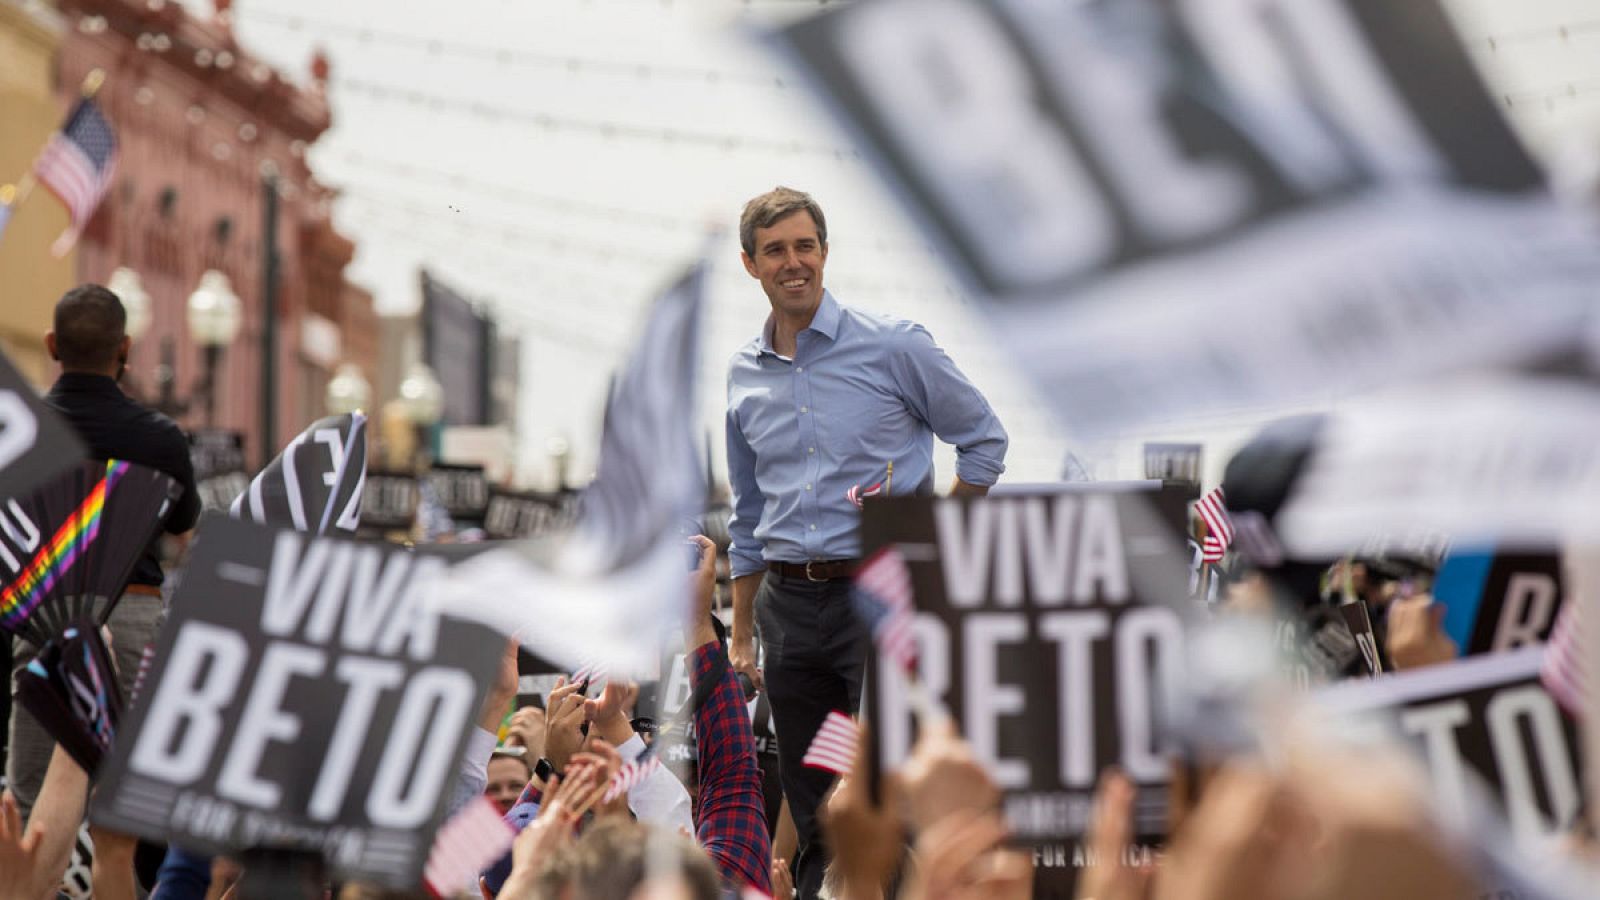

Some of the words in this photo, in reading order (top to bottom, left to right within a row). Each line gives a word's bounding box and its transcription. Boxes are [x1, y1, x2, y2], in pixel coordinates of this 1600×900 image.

[259, 528, 442, 662] VIVA
[935, 497, 1131, 605] VIVA
[128, 618, 477, 831] BETO
[1072, 845, 1152, 867] AMICA
